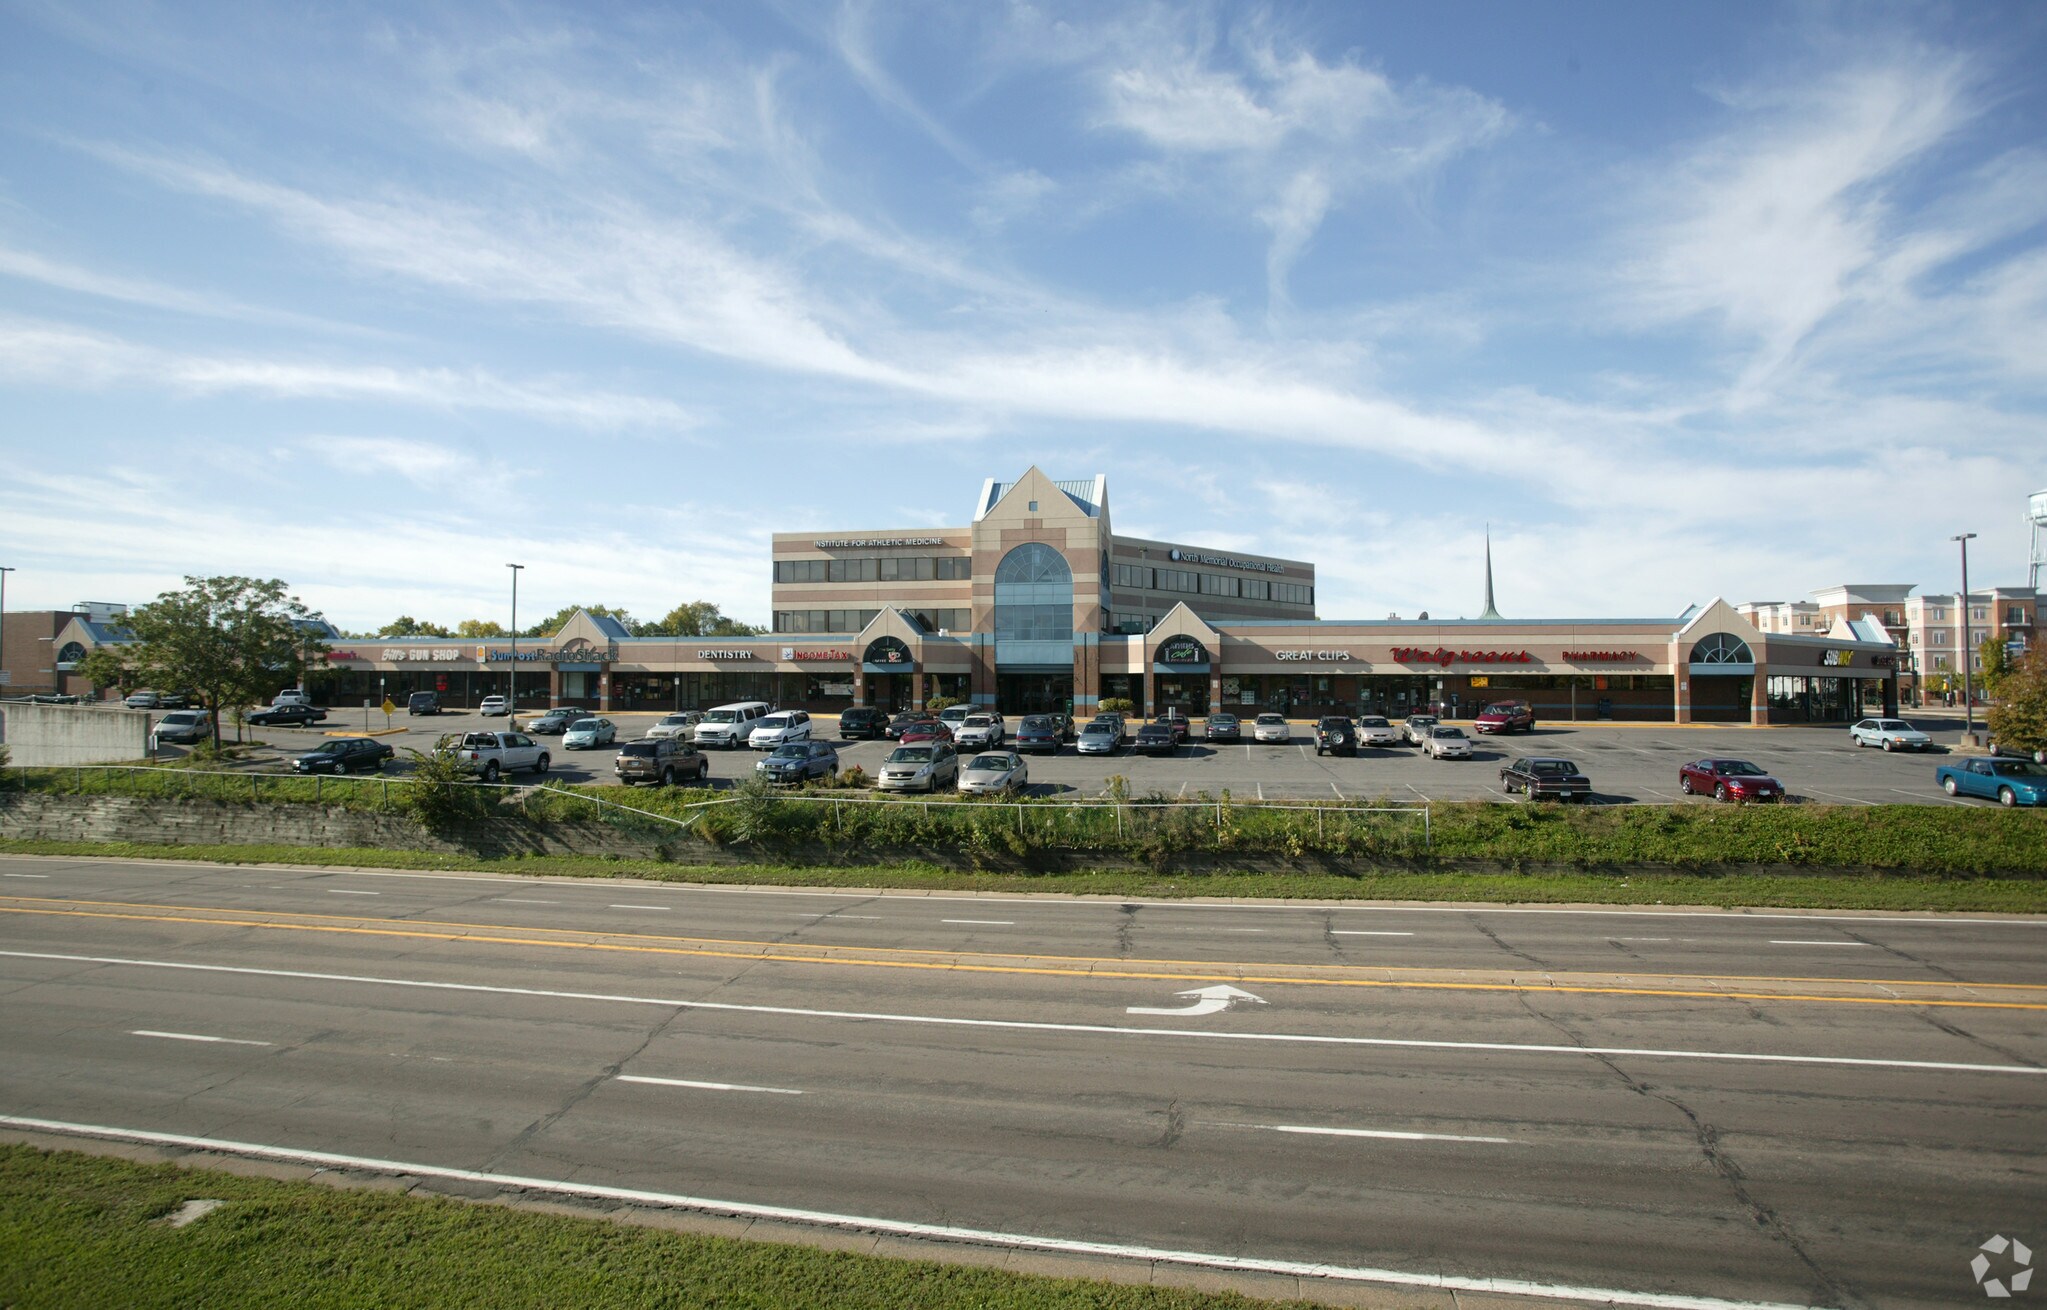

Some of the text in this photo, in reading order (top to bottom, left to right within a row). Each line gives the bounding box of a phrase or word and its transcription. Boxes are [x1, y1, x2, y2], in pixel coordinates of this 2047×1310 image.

[814, 540, 848, 548] INSTITUTE
[1180, 551, 1285, 574] North Memorial Occupational Health
[381, 649, 459, 661] Bill's GUN SHOP
[698, 650, 752, 659] DENTISTRY
[795, 649, 848, 660] INCOME TAX
[1275, 650, 1350, 661] GREAT CLIPS
[1390, 647, 1532, 667] Walgreens
[1562, 651, 1637, 661] PHARMACY
